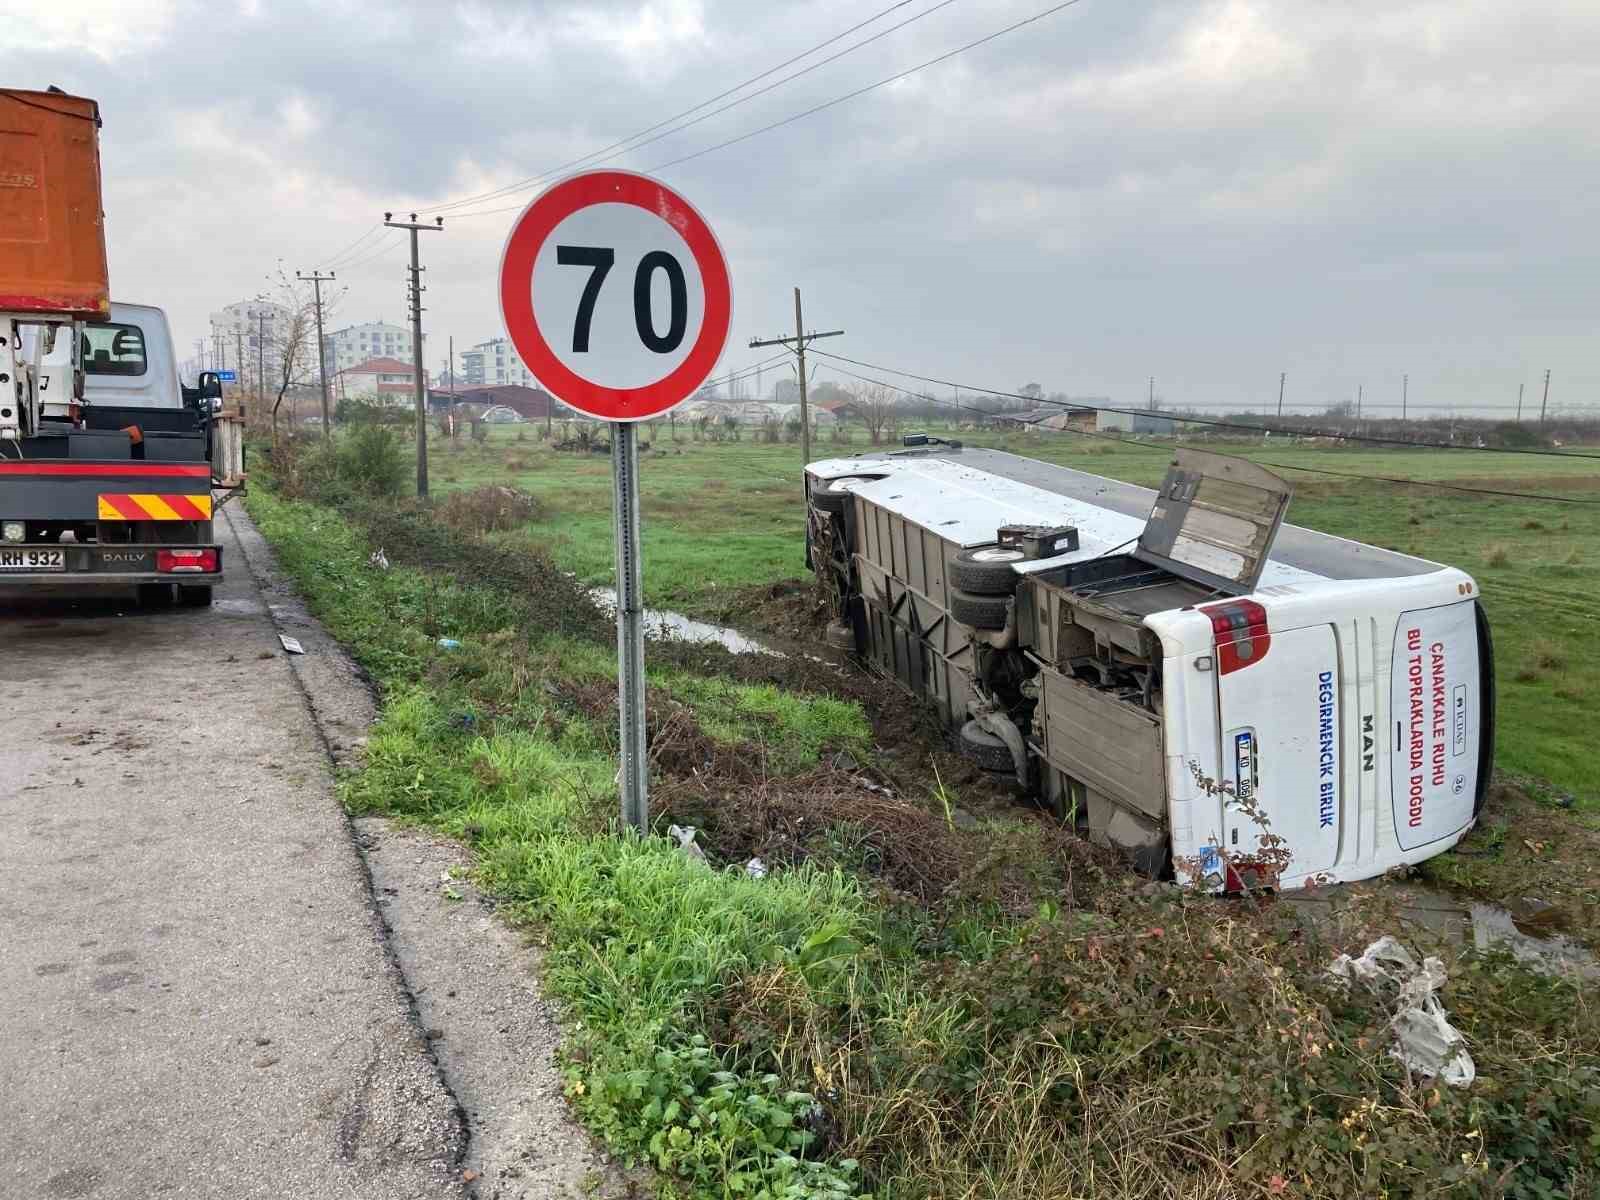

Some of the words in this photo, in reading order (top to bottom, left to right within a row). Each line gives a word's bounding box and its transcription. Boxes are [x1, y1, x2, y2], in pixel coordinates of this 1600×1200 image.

[557, 245, 687, 353] 70
[1, 551, 24, 565] RH
[29, 551, 61, 565] 932
[103, 553, 145, 562] DAILY
[1407, 628, 1421, 651] BU
[1409, 656, 1424, 770] TOPRAKLARDA
[1429, 642, 1446, 739] ÇANAKKALE
[1319, 671, 1335, 778] DEĞİRMENCİK
[1362, 714, 1374, 772] MAN
[1432, 743, 1445, 786] RUHU
[1320, 782, 1335, 829] BİRLİK
[1408, 775, 1425, 828] DOĞDU
